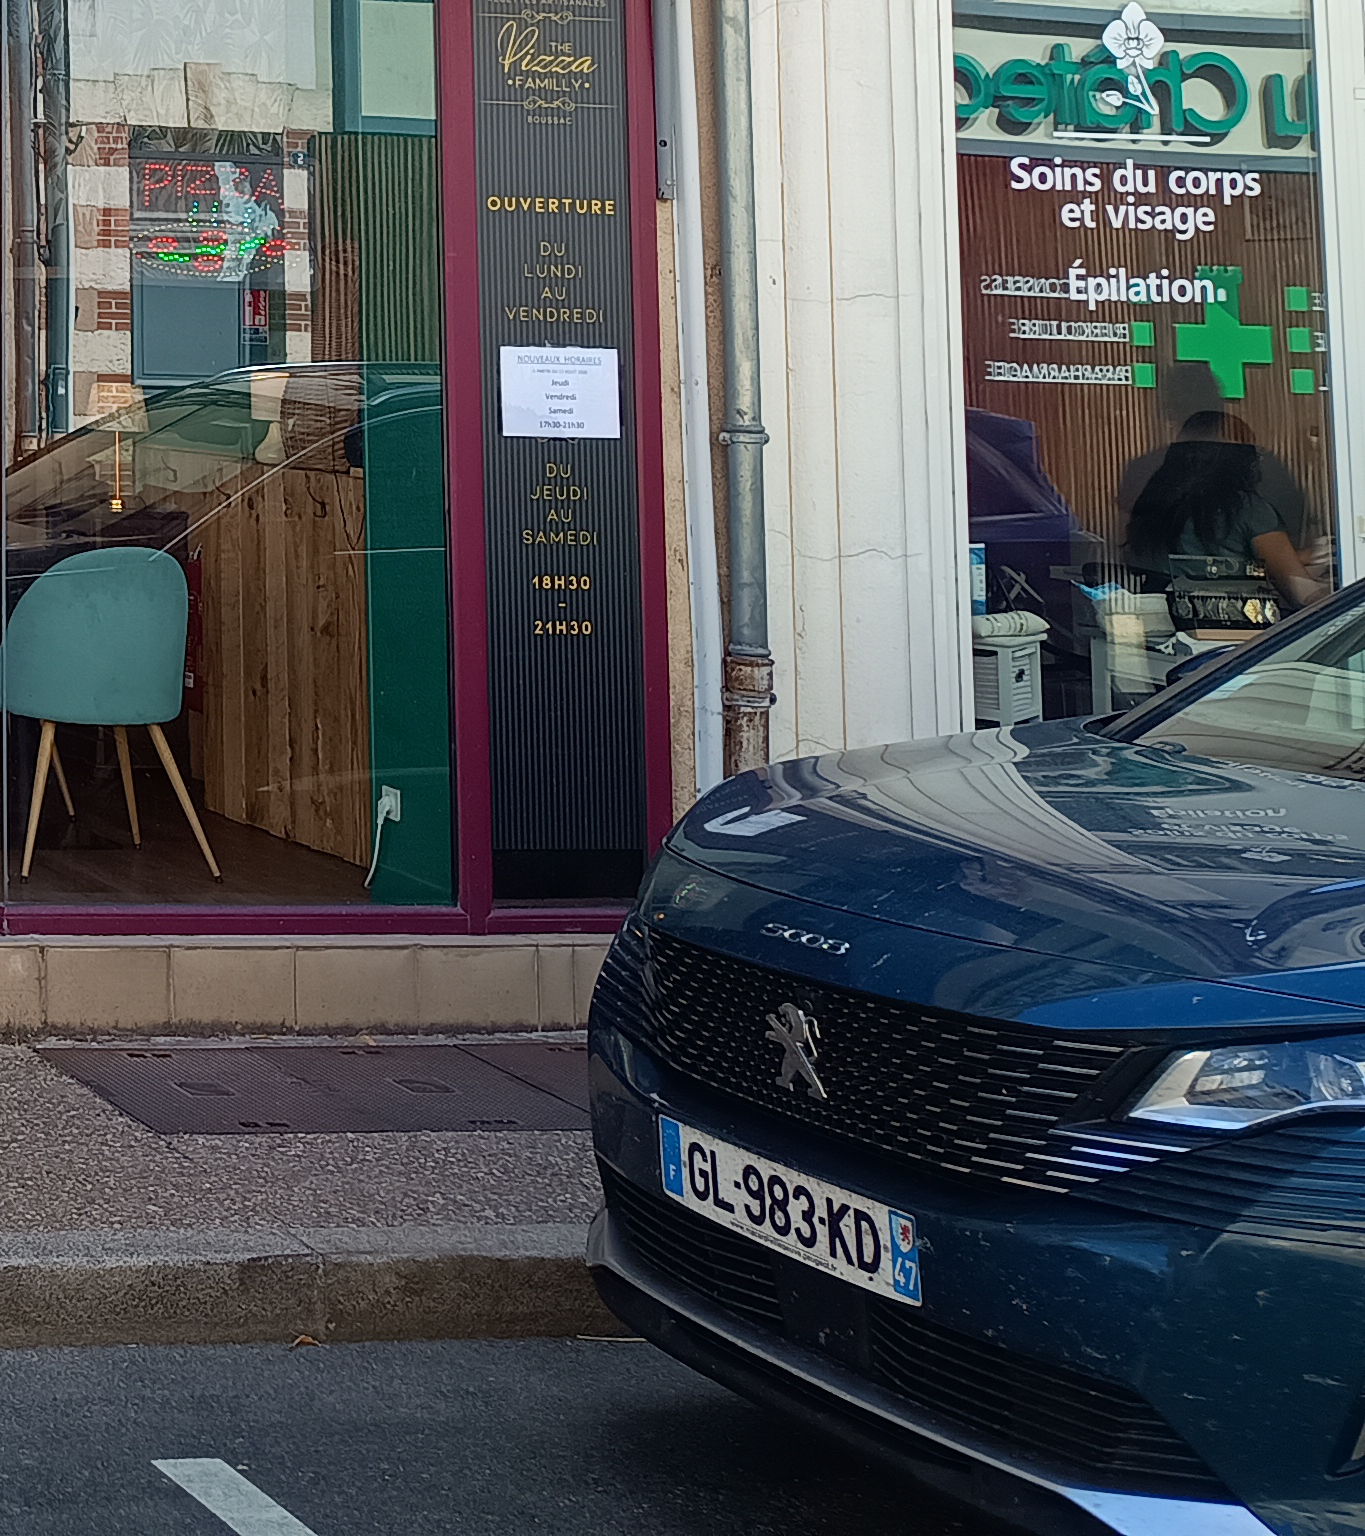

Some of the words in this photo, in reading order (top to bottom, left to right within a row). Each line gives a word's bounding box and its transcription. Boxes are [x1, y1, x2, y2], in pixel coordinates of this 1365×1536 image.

[498, 21, 598, 74] Pizza
[549, 42, 573, 53] THE
[527, 115, 572, 125] BOUSSAC
[1010, 157, 1101, 192] Soins
[1113, 159, 1155, 194] du
[1169, 169, 1263, 205] corps
[487, 196, 615, 214] OUVERTURE
[1061, 197, 1096, 229] et
[1105, 196, 1216, 240] visage
[540, 242, 565, 256] DU
[524, 264, 582, 279] LUNDI
[1068, 259, 1215, 311] Épilation
[541, 287, 566, 300] AU
[505, 308, 604, 323] VENDREDI
[517, 355, 560, 364] NOUVEAUX
[539, 421, 585, 429] 17h30-21h30
[546, 463, 571, 478] DU
[530, 486, 588, 500] JEUDI
[547, 509, 572, 522] AU
[523, 530, 598, 545] SAMEDI
[532, 576, 591, 590] 18H30
[534, 621, 593, 635] 21H30
[669, 1164, 676, 1180] F
[688, 1142, 882, 1274] GL-983-KD
[895, 1257, 917, 1291] 47
